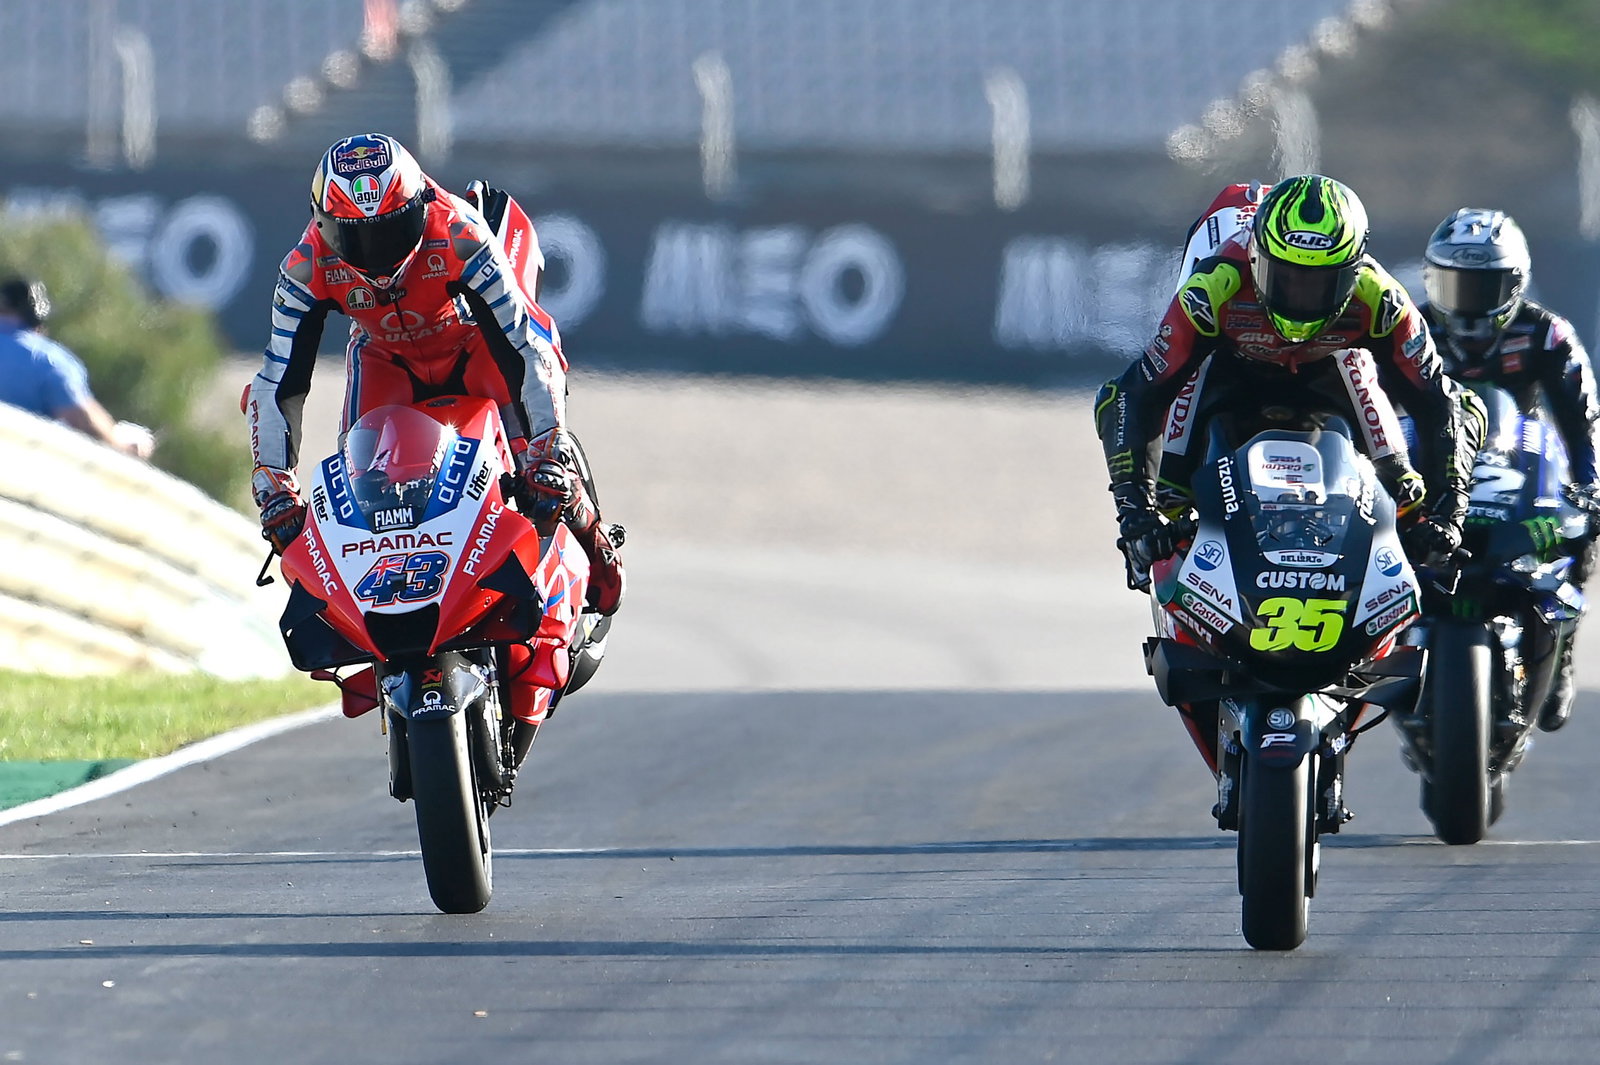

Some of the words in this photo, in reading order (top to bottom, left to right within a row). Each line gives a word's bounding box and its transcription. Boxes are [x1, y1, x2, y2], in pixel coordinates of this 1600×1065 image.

[338, 160, 361, 173] Red
[363, 154, 388, 169] Bull
[356, 191, 378, 203] agv
[1287, 233, 1328, 247] HJC
[640, 218, 904, 346] MEO
[438, 440, 472, 504] OCTO
[1217, 456, 1240, 514] rizoma
[328, 458, 354, 519] OCTO
[374, 507, 413, 527] FIAMM
[341, 532, 453, 558] PRAMAC
[463, 502, 505, 576] PRAMAC
[302, 527, 339, 596] PRAMAC
[353, 550, 451, 608] 43
[1186, 572, 1233, 610] SENA
[1256, 571, 1345, 592] CUSTOM
[1365, 580, 1412, 612] SENA
[1192, 601, 1229, 632] Castrol
[1249, 597, 1348, 652] 35
[1376, 601, 1410, 629] Castrol
[412, 704, 456, 718] PRAMAC
